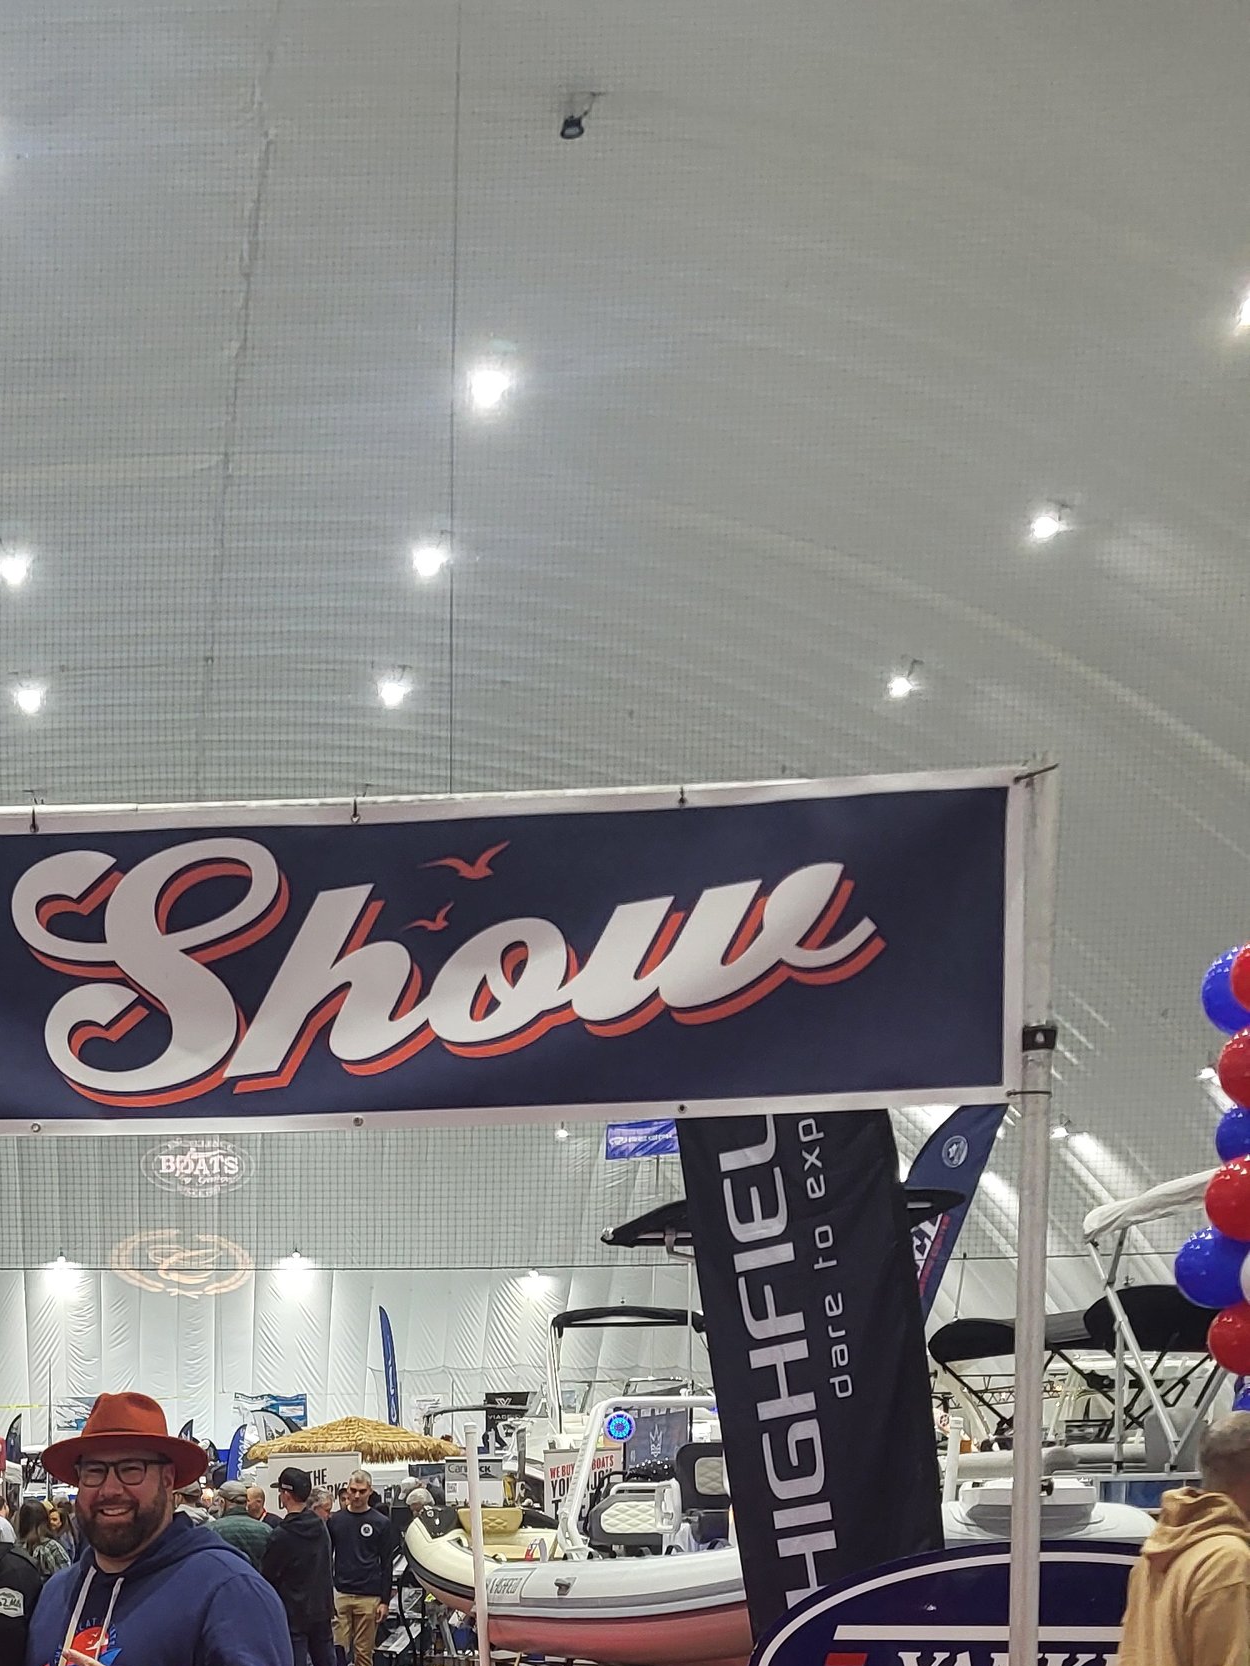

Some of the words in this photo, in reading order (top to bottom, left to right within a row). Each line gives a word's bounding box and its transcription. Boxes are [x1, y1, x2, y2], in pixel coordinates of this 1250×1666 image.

[11, 836, 882, 1106] Show
[159, 1155, 240, 1175] BOATS
[798, 1117, 826, 1199] exp
[813, 1224, 837, 1271] to
[718, 1114, 837, 1608] HIGHFIEL
[829, 1292, 852, 1398] dare
[550, 1466, 561, 1480] WE
[592, 1454, 614, 1471] BOATS
